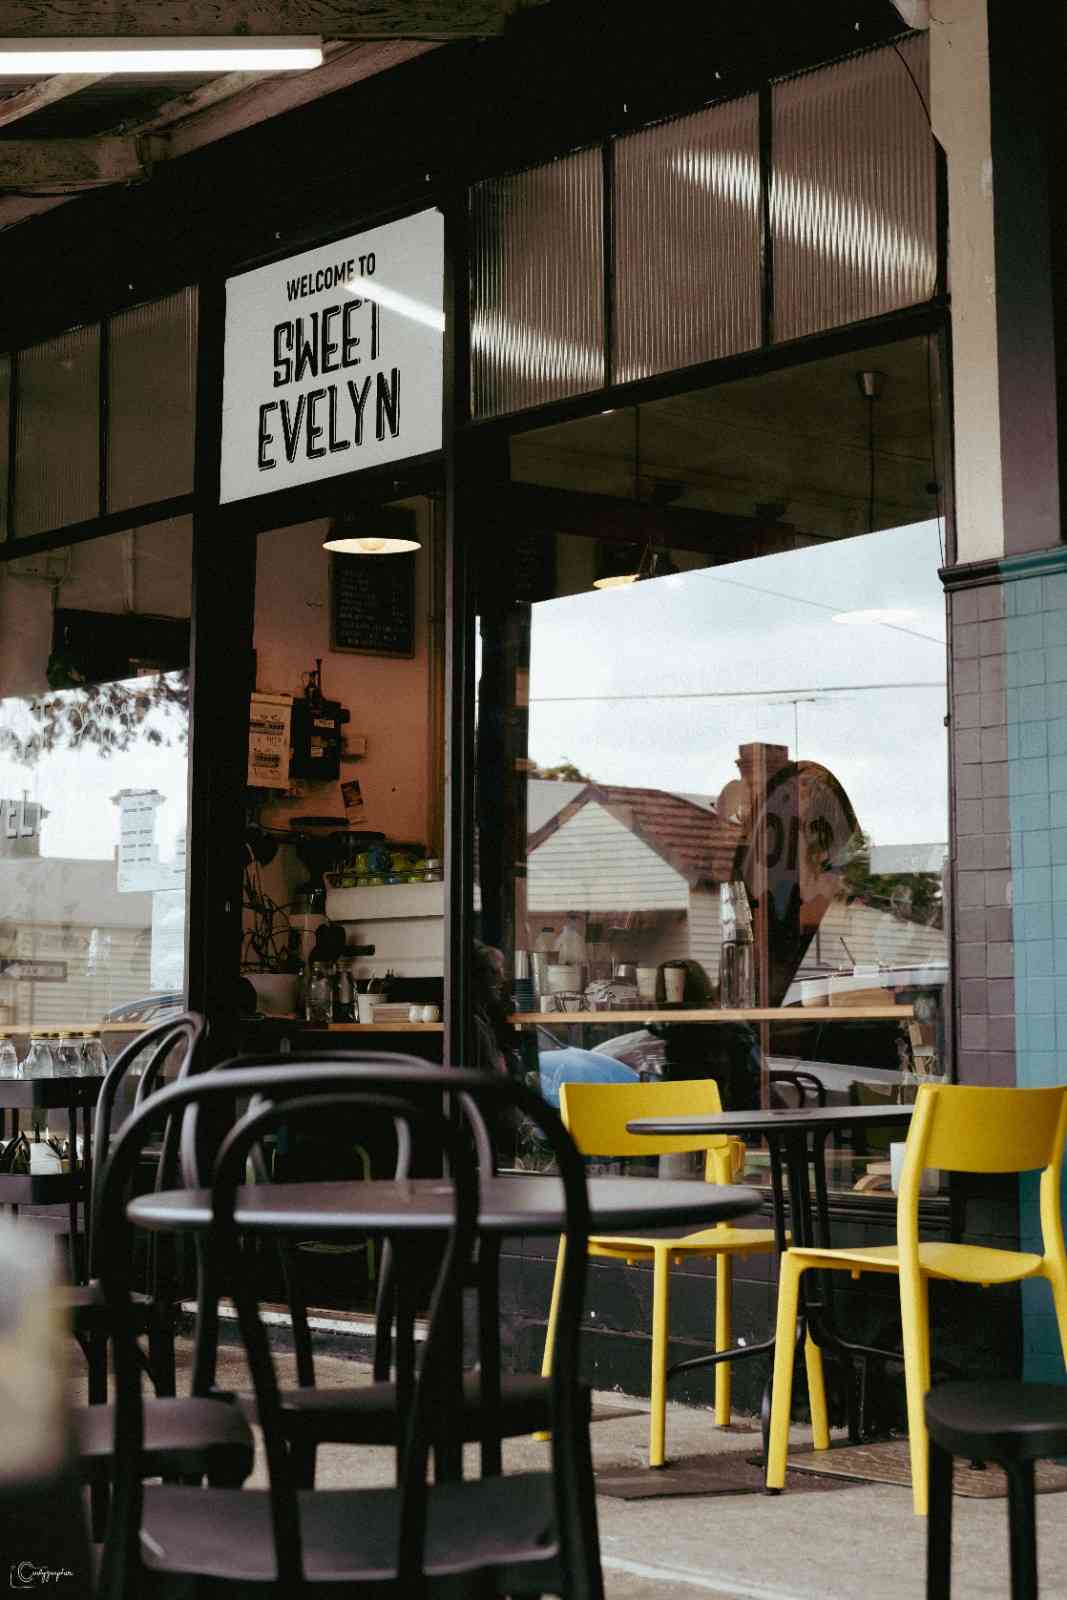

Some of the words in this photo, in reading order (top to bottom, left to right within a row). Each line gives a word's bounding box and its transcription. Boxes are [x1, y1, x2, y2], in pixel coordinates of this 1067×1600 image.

[287, 259, 354, 301] WELCOME
[358, 252, 376, 277] TO
[273, 298, 380, 387] SWEET
[257, 367, 401, 471] EVELYN
